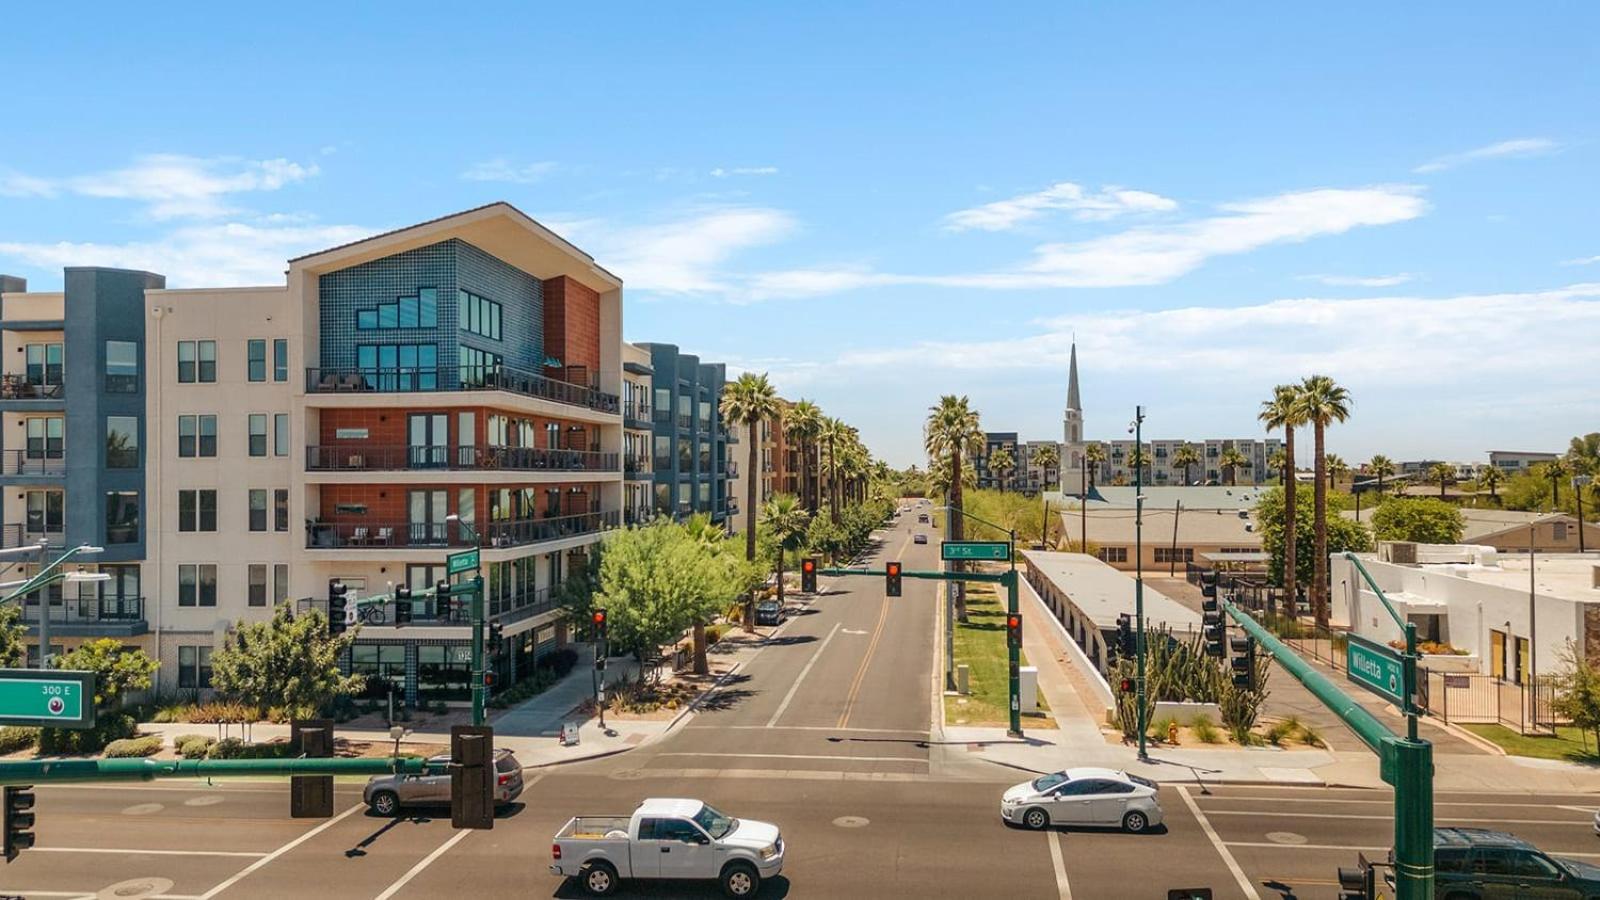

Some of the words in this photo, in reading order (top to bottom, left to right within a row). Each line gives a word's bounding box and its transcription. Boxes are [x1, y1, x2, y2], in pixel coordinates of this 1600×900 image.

[1353, 652, 1381, 679] Willetta
[42, 686, 61, 695] 300
[65, 686, 71, 695] E
